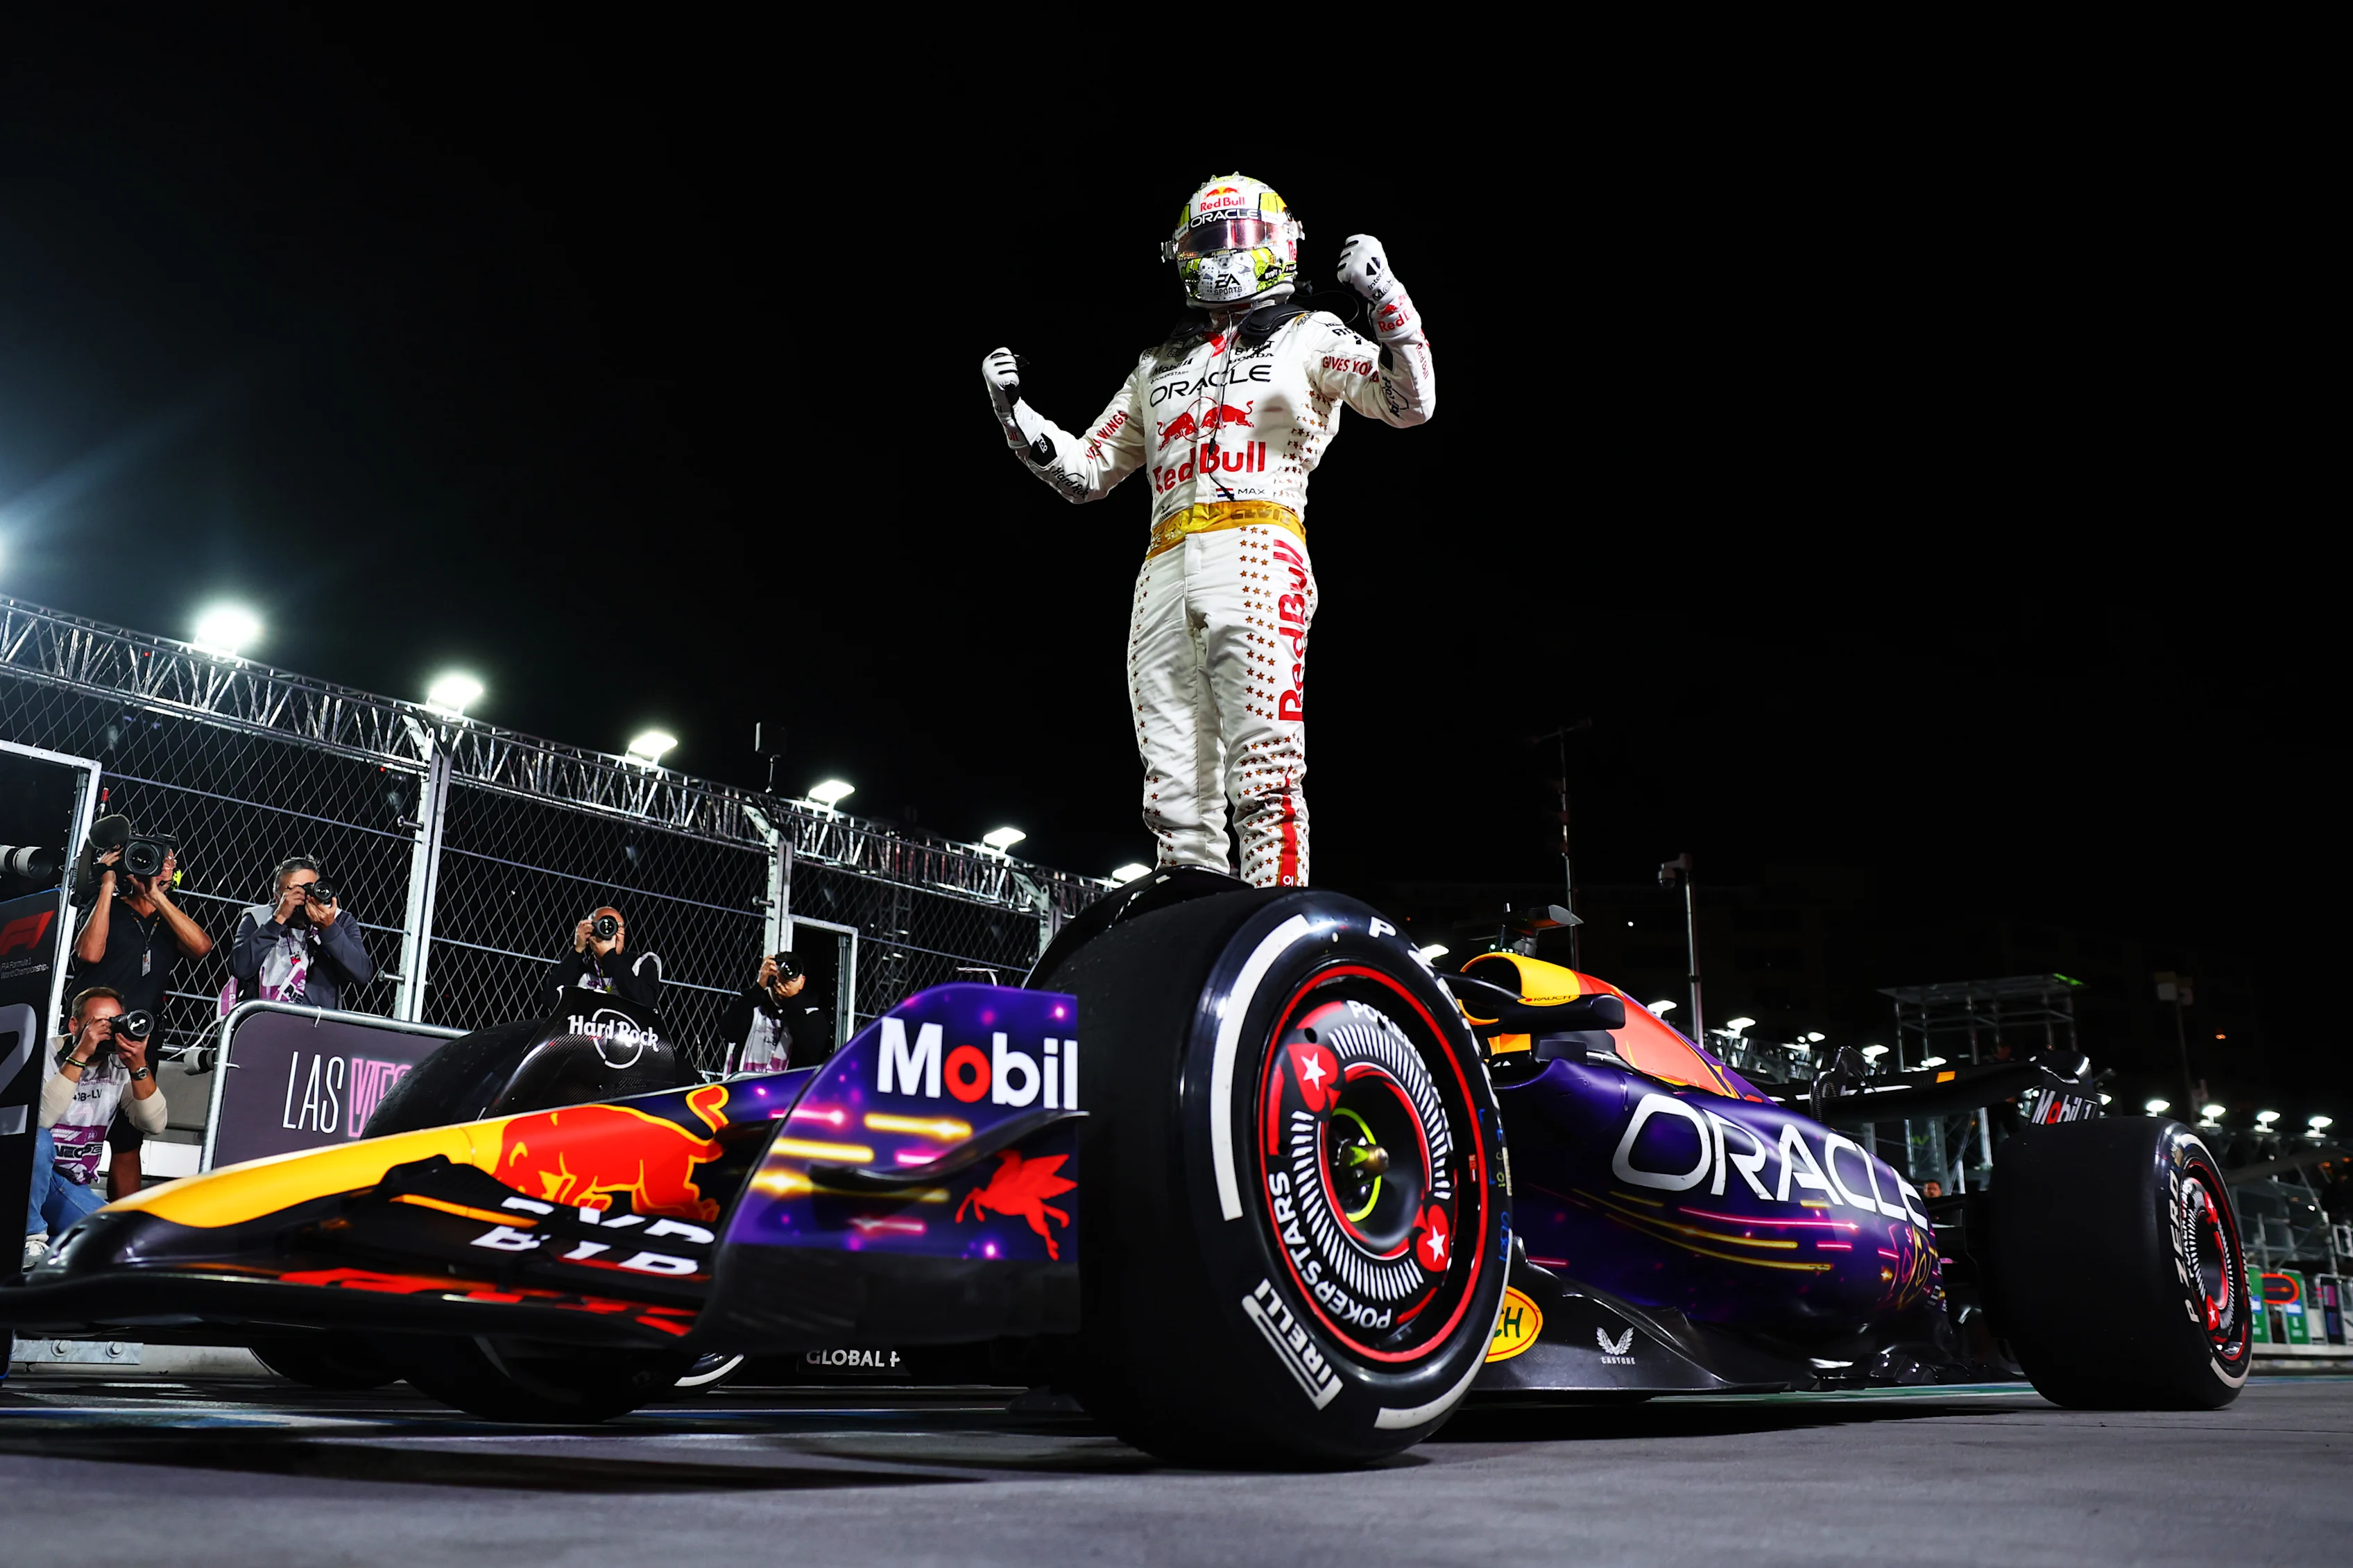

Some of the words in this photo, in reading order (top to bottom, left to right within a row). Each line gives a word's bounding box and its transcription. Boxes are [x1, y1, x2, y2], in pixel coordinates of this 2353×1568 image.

[1190, 209, 1259, 227] ORACLE
[1200, 198, 1221, 212] Red
[1223, 196, 1245, 207] Bull
[1214, 286, 1242, 296] SPORTS
[1215, 273, 1241, 288] EA
[1322, 356, 1351, 372] GIVES
[1149, 365, 1272, 408] ORACLE
[1097, 410, 1130, 440] WINGS
[1199, 440, 1266, 474] Bull
[1273, 538, 1308, 626] Bull
[1278, 626, 1305, 722] Red
[568, 1015, 615, 1040] Hard
[615, 1020, 660, 1053] Rock
[876, 1016, 1078, 1110] Mobil
[282, 1051, 345, 1134] LAS
[348, 1058, 414, 1138] VE
[1613, 1092, 1928, 1232] ORACLE
[2169, 1169, 2191, 1289] ZERO
[1269, 1171, 1392, 1329] POKERSTARS
[2184, 1298, 2200, 1323] P
[806, 1349, 885, 1368] GLOBAL
[1242, 1277, 1344, 1411] PIRELLI
[1600, 1356, 1636, 1365] CASTORE
